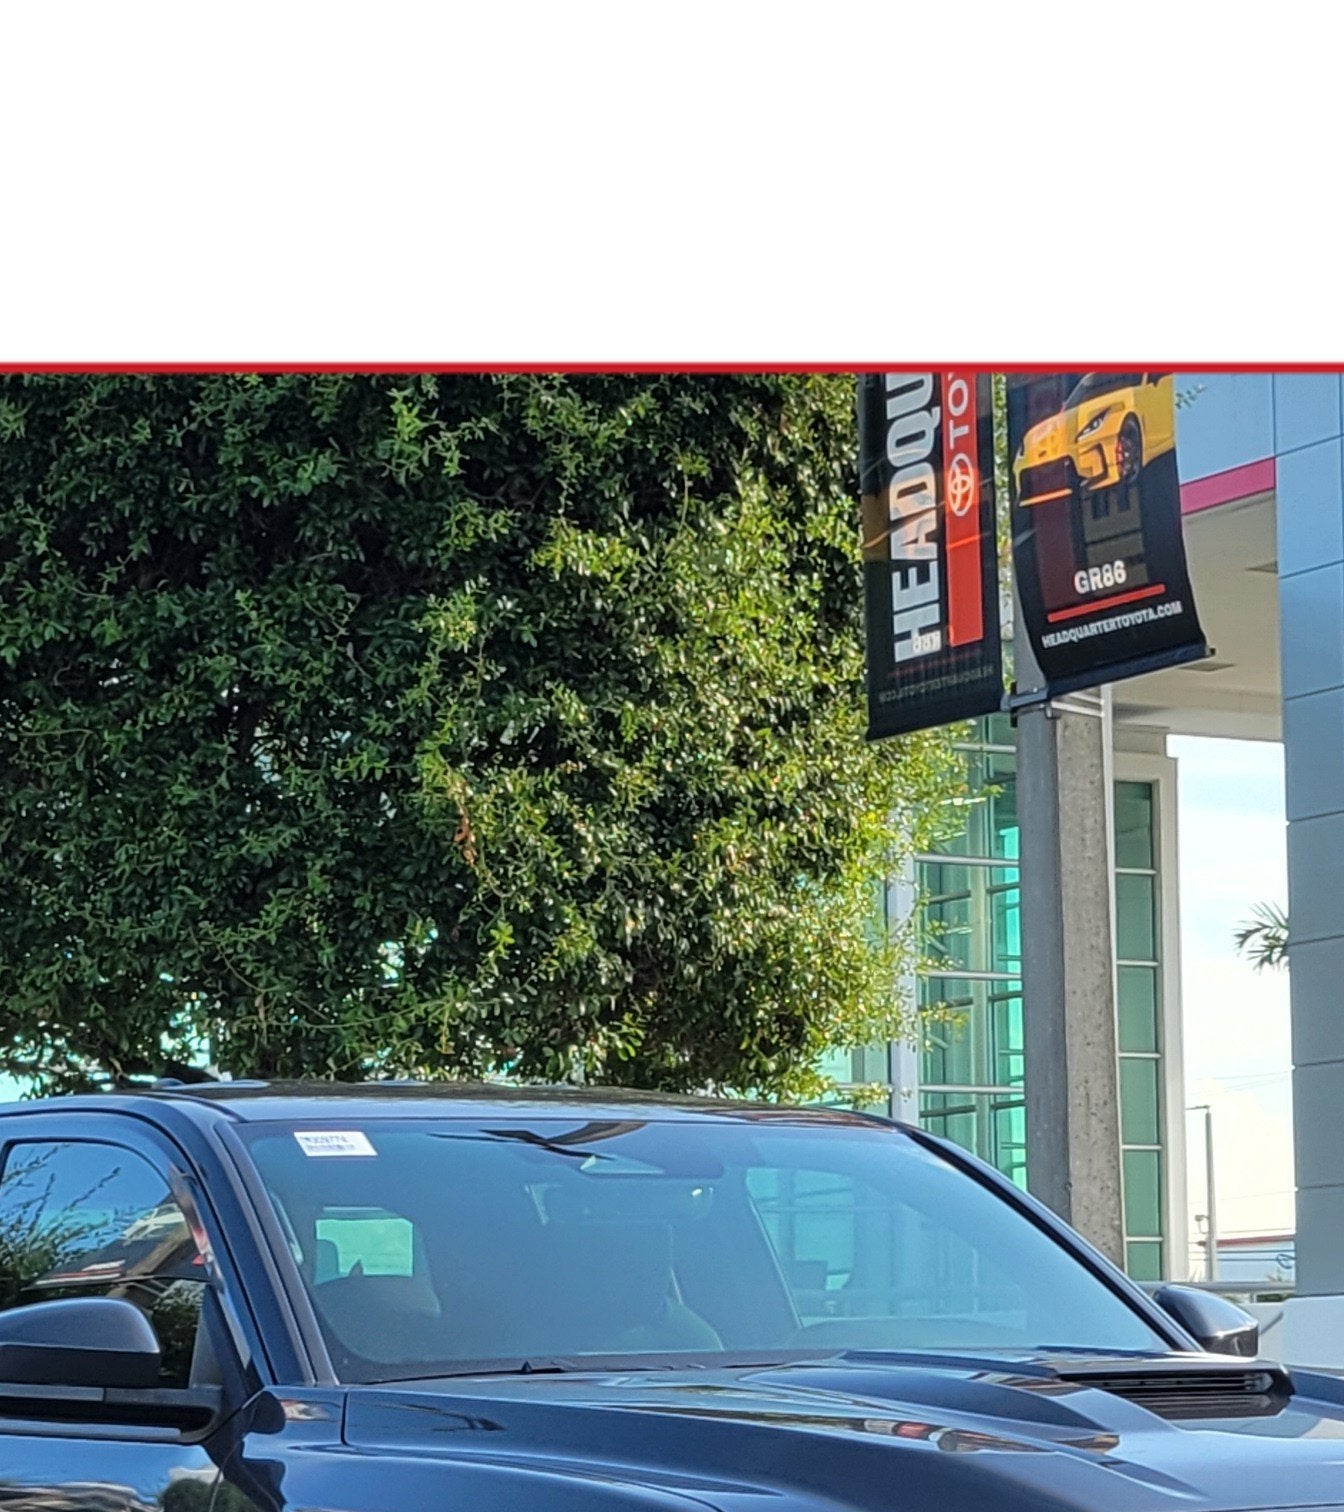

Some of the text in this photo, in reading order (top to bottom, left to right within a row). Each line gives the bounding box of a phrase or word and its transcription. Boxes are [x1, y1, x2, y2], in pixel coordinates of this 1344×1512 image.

[947, 373, 969, 450] TO
[1074, 560, 1127, 594] GR86
[1041, 601, 1183, 648] HEADQUARTERTOYOTA.COM
